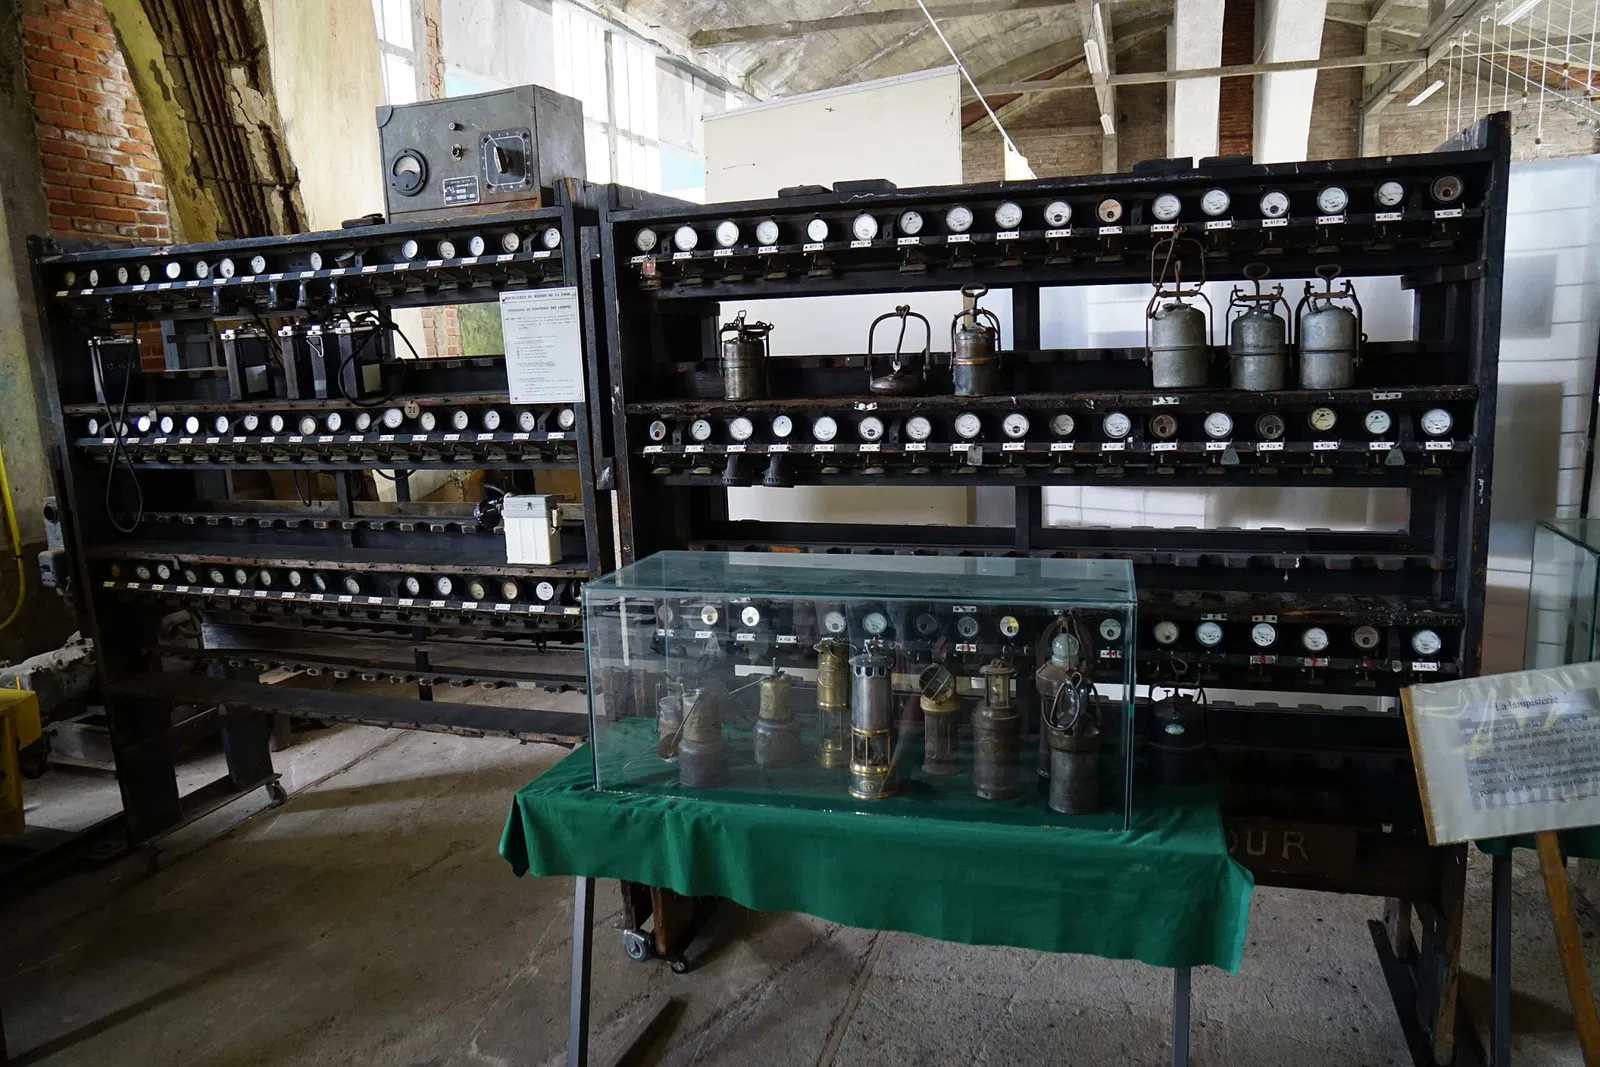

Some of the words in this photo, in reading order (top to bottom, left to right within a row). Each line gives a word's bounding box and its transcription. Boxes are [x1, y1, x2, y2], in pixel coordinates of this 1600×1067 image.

[1495, 702, 1508, 711] La
[1508, 696, 1558, 710] lampisterie
[1492, 734, 1516, 744] prenait
[1494, 744, 1502, 752] de
[1504, 742, 1527, 753] charge
[1477, 757, 1498, 767] lampe
[1568, 744, 1589, 754] Quand
[1480, 786, 1510, 797] pointage
[1512, 785, 1524, 794] qui
